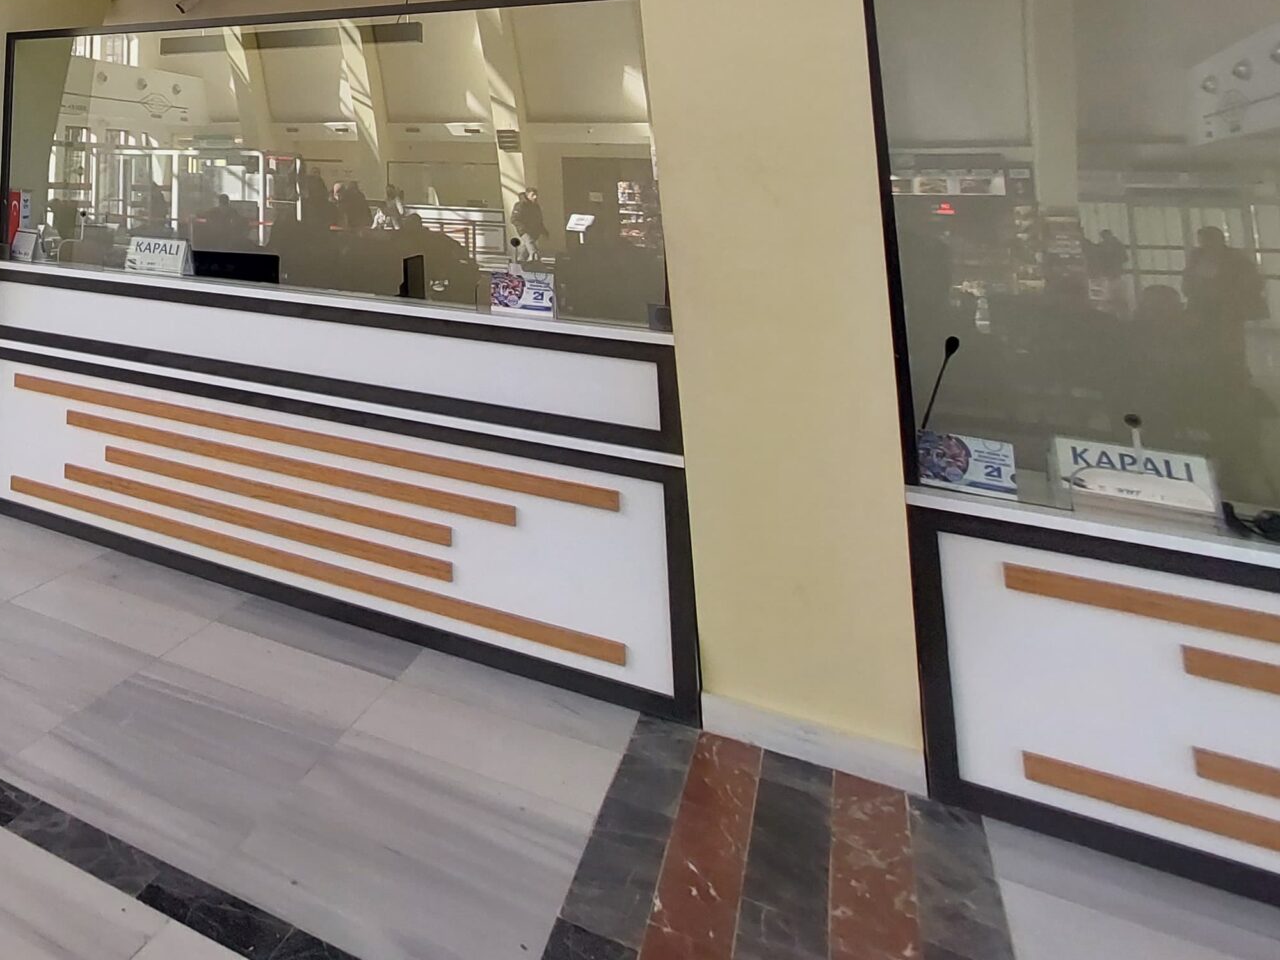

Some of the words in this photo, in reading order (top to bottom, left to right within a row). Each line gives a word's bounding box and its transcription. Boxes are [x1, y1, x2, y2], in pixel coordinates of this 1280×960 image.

[135, 240, 180, 256] KAPALI
[984, 465, 1002, 479] 21
[1071, 446, 1194, 482] KAPALI
